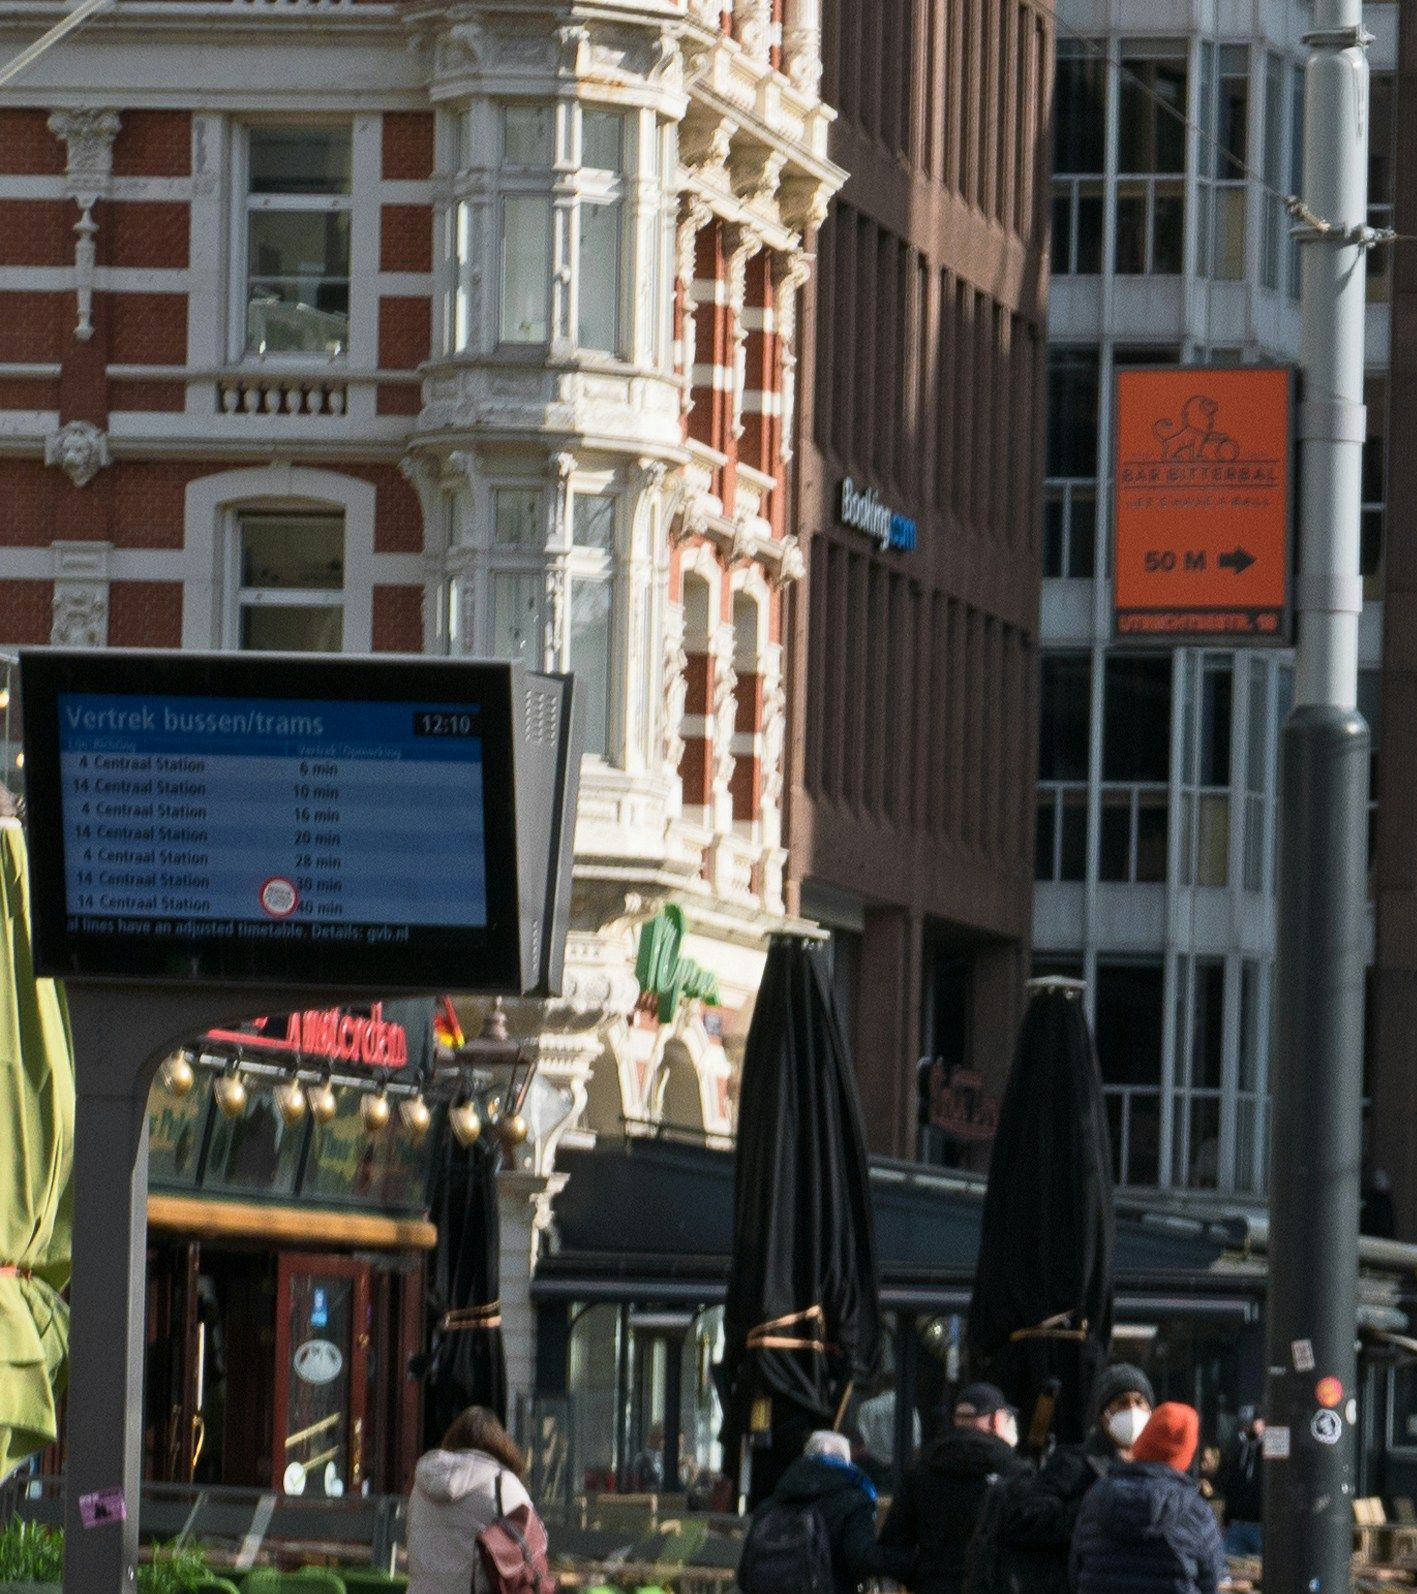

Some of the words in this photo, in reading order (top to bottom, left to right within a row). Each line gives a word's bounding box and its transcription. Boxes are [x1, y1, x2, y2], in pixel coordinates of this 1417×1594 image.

[1122, 467, 1160, 483] BAR
[1167, 466, 1279, 482] BITTERBAL
[1145, 551, 1176, 573] 50
[1185, 551, 1206, 571] M
[66, 705, 155, 730] Vertrek
[164, 708, 324, 736] bussen/trams
[421, 714, 471, 734] 12:10
[78, 756, 88, 769] 4
[93, 755, 152, 771] Centraal
[155, 756, 205, 774] Station
[299, 761, 309, 776] 6
[312, 761, 338, 776] min
[73, 778, 89, 793] 14
[94, 778, 153, 795] Centraal
[155, 780, 206, 797] Station
[293, 784, 310, 799] 10
[313, 784, 340, 800] min
[81, 802, 90, 816] 4
[95, 802, 154, 818] Centraal
[156, 803, 207, 820] Station
[294, 807, 311, 823] 16
[314, 807, 340, 824] min
[75, 825, 91, 838] 14
[96, 825, 155, 841] Centraal
[157, 826, 208, 843] Station
[294, 830, 311, 845] 20
[314, 831, 341, 846] min
[83, 848, 92, 862] 4
[97, 848, 156, 864] Centraal
[158, 849, 209, 866] Station
[294, 854, 312, 868] 28
[315, 854, 342, 869] min
[76, 871, 93, 885] 14
[98, 871, 157, 888] Centraal
[159, 872, 210, 889] Station
[316, 877, 343, 893] min
[77, 895, 94, 908] 14
[99, 894, 157, 910] Centraal
[159, 896, 211, 912] Station
[317, 900, 343, 916] min
[82, 917, 114, 934] lines
[118, 918, 151, 934] have
[154, 921, 172, 934] an
[175, 919, 234, 939] adjusted
[312, 923, 364, 940] Details:
[366, 926, 410, 943] gvb.nl
